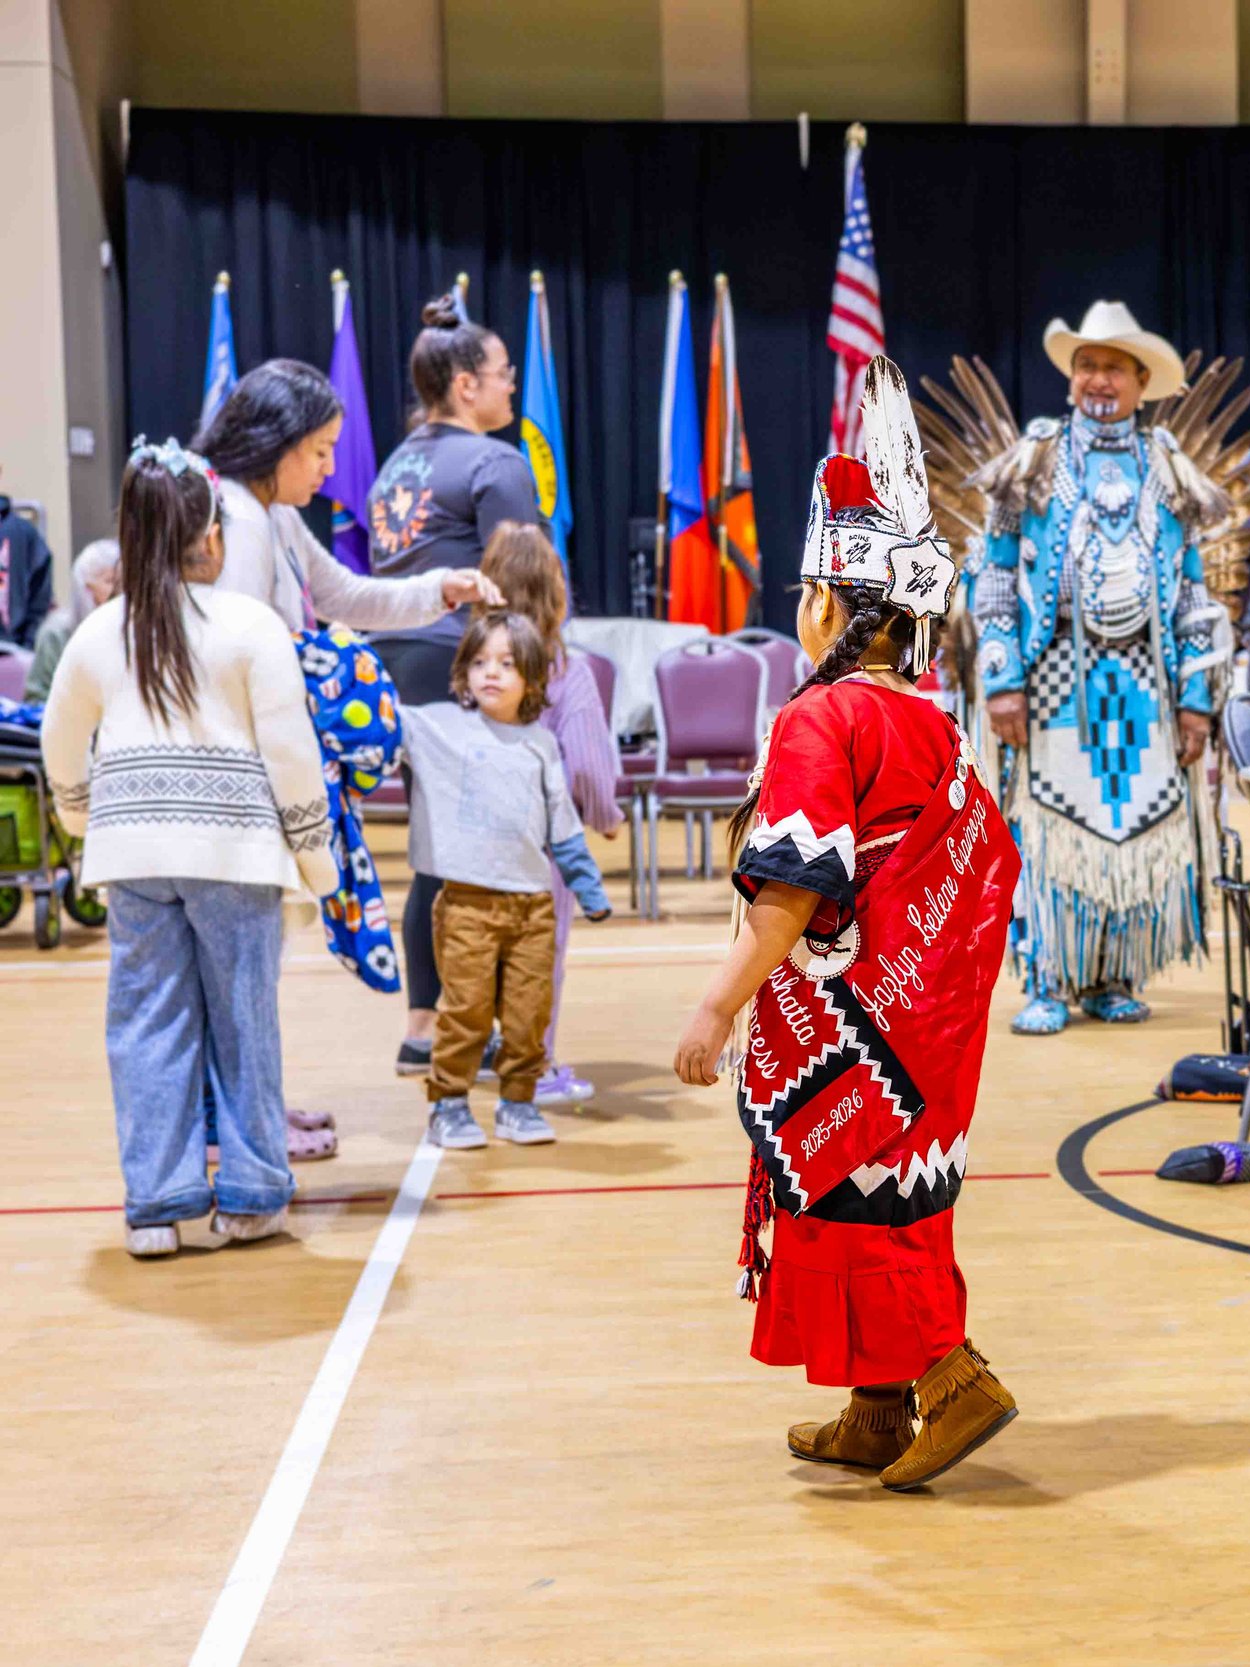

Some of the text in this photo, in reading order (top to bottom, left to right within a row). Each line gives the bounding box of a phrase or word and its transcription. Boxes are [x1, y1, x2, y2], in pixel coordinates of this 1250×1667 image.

[852, 797, 988, 1032] Jazlyn Leilene Espinoza
[750, 1007, 780, 1079] ncess
[768, 965, 816, 1046] ushatta
[800, 1088, 863, 1161] 2025-2026
